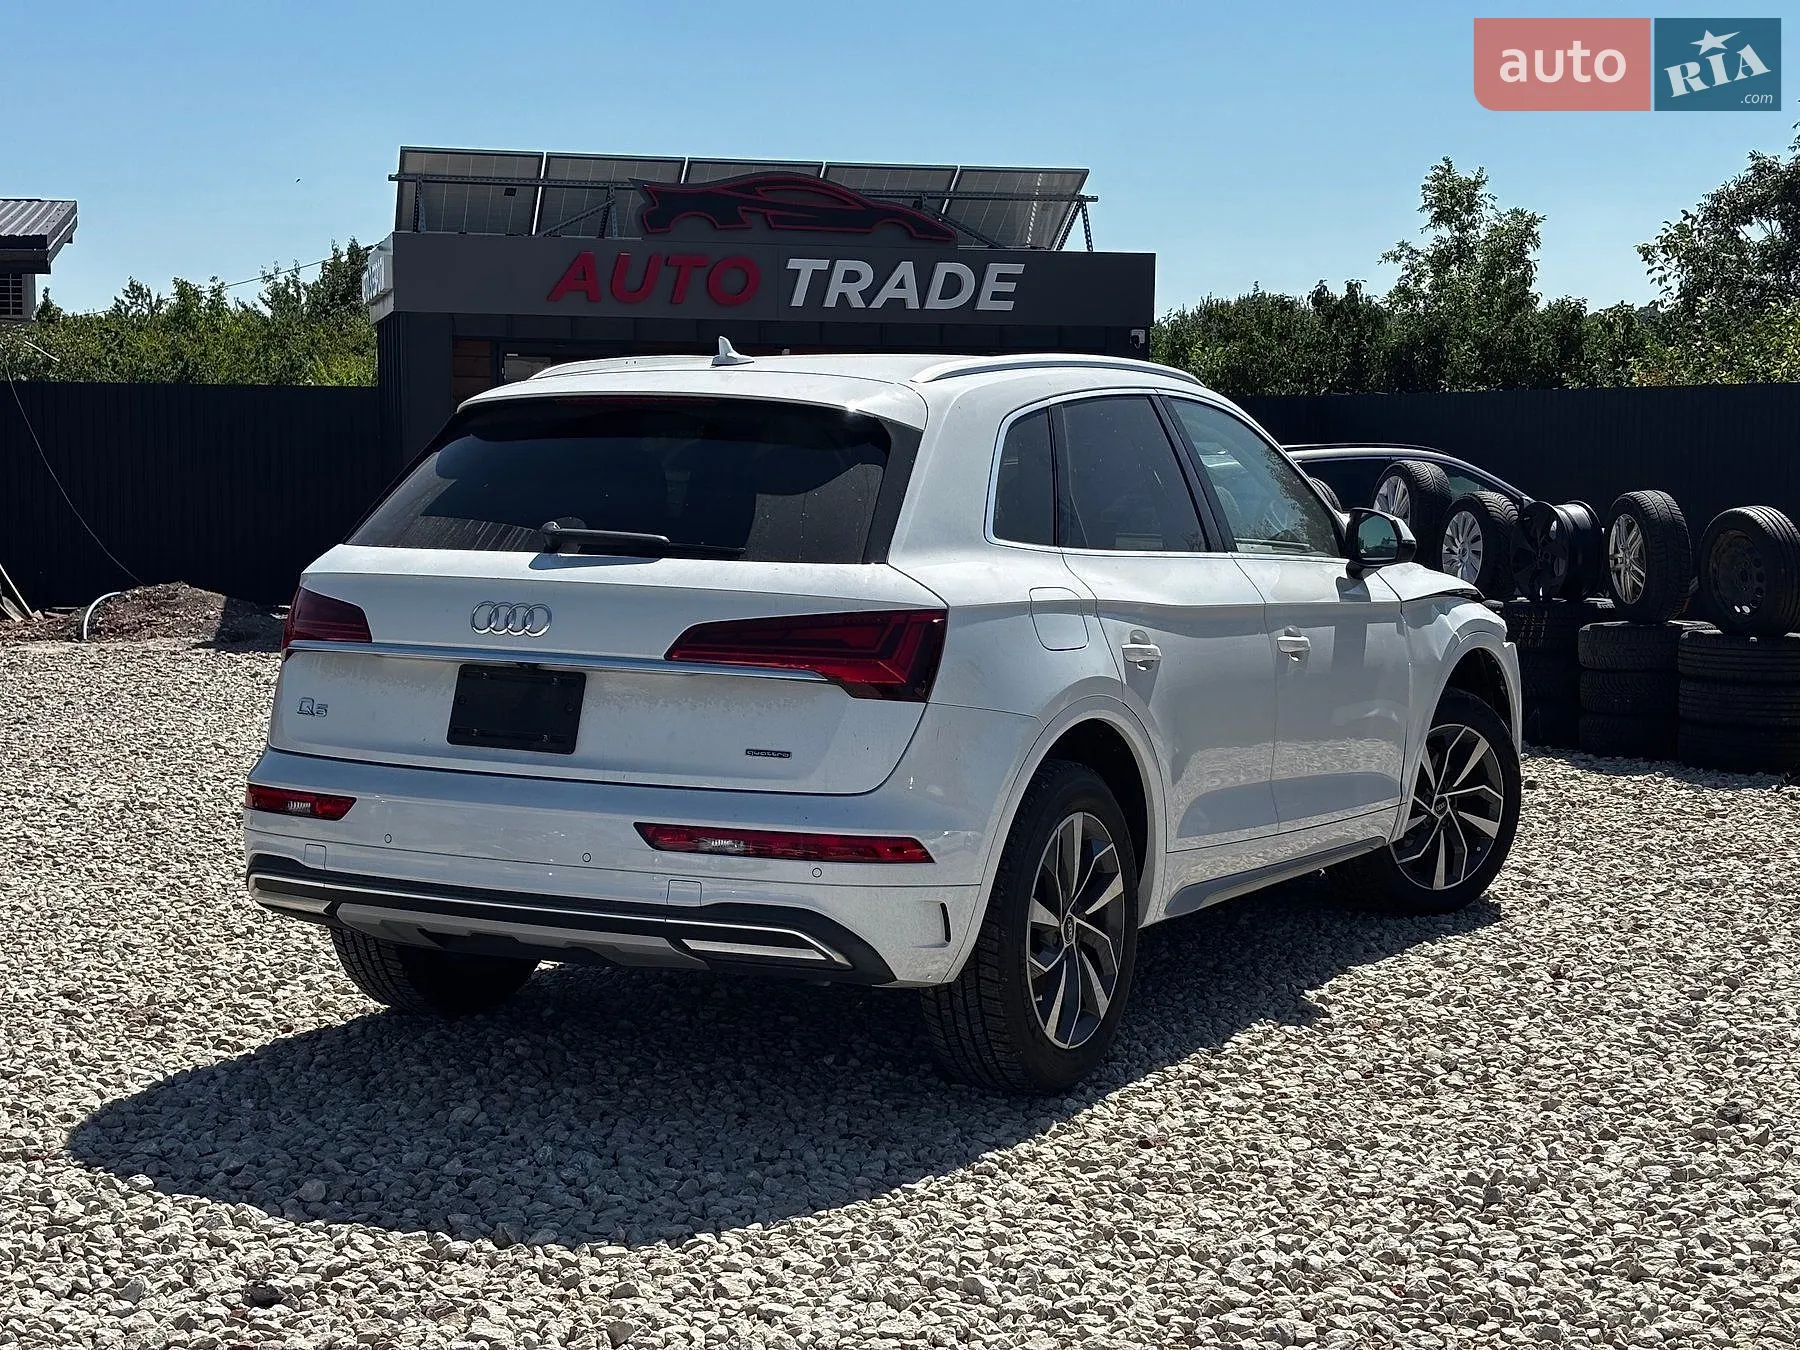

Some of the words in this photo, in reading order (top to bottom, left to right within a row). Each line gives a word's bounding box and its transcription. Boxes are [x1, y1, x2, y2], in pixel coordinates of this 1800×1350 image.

[548, 252, 761, 305] AUTO
[785, 257, 1025, 311] TRADE
[297, 697, 329, 718] Q5
[746, 749, 790, 758] quattro
